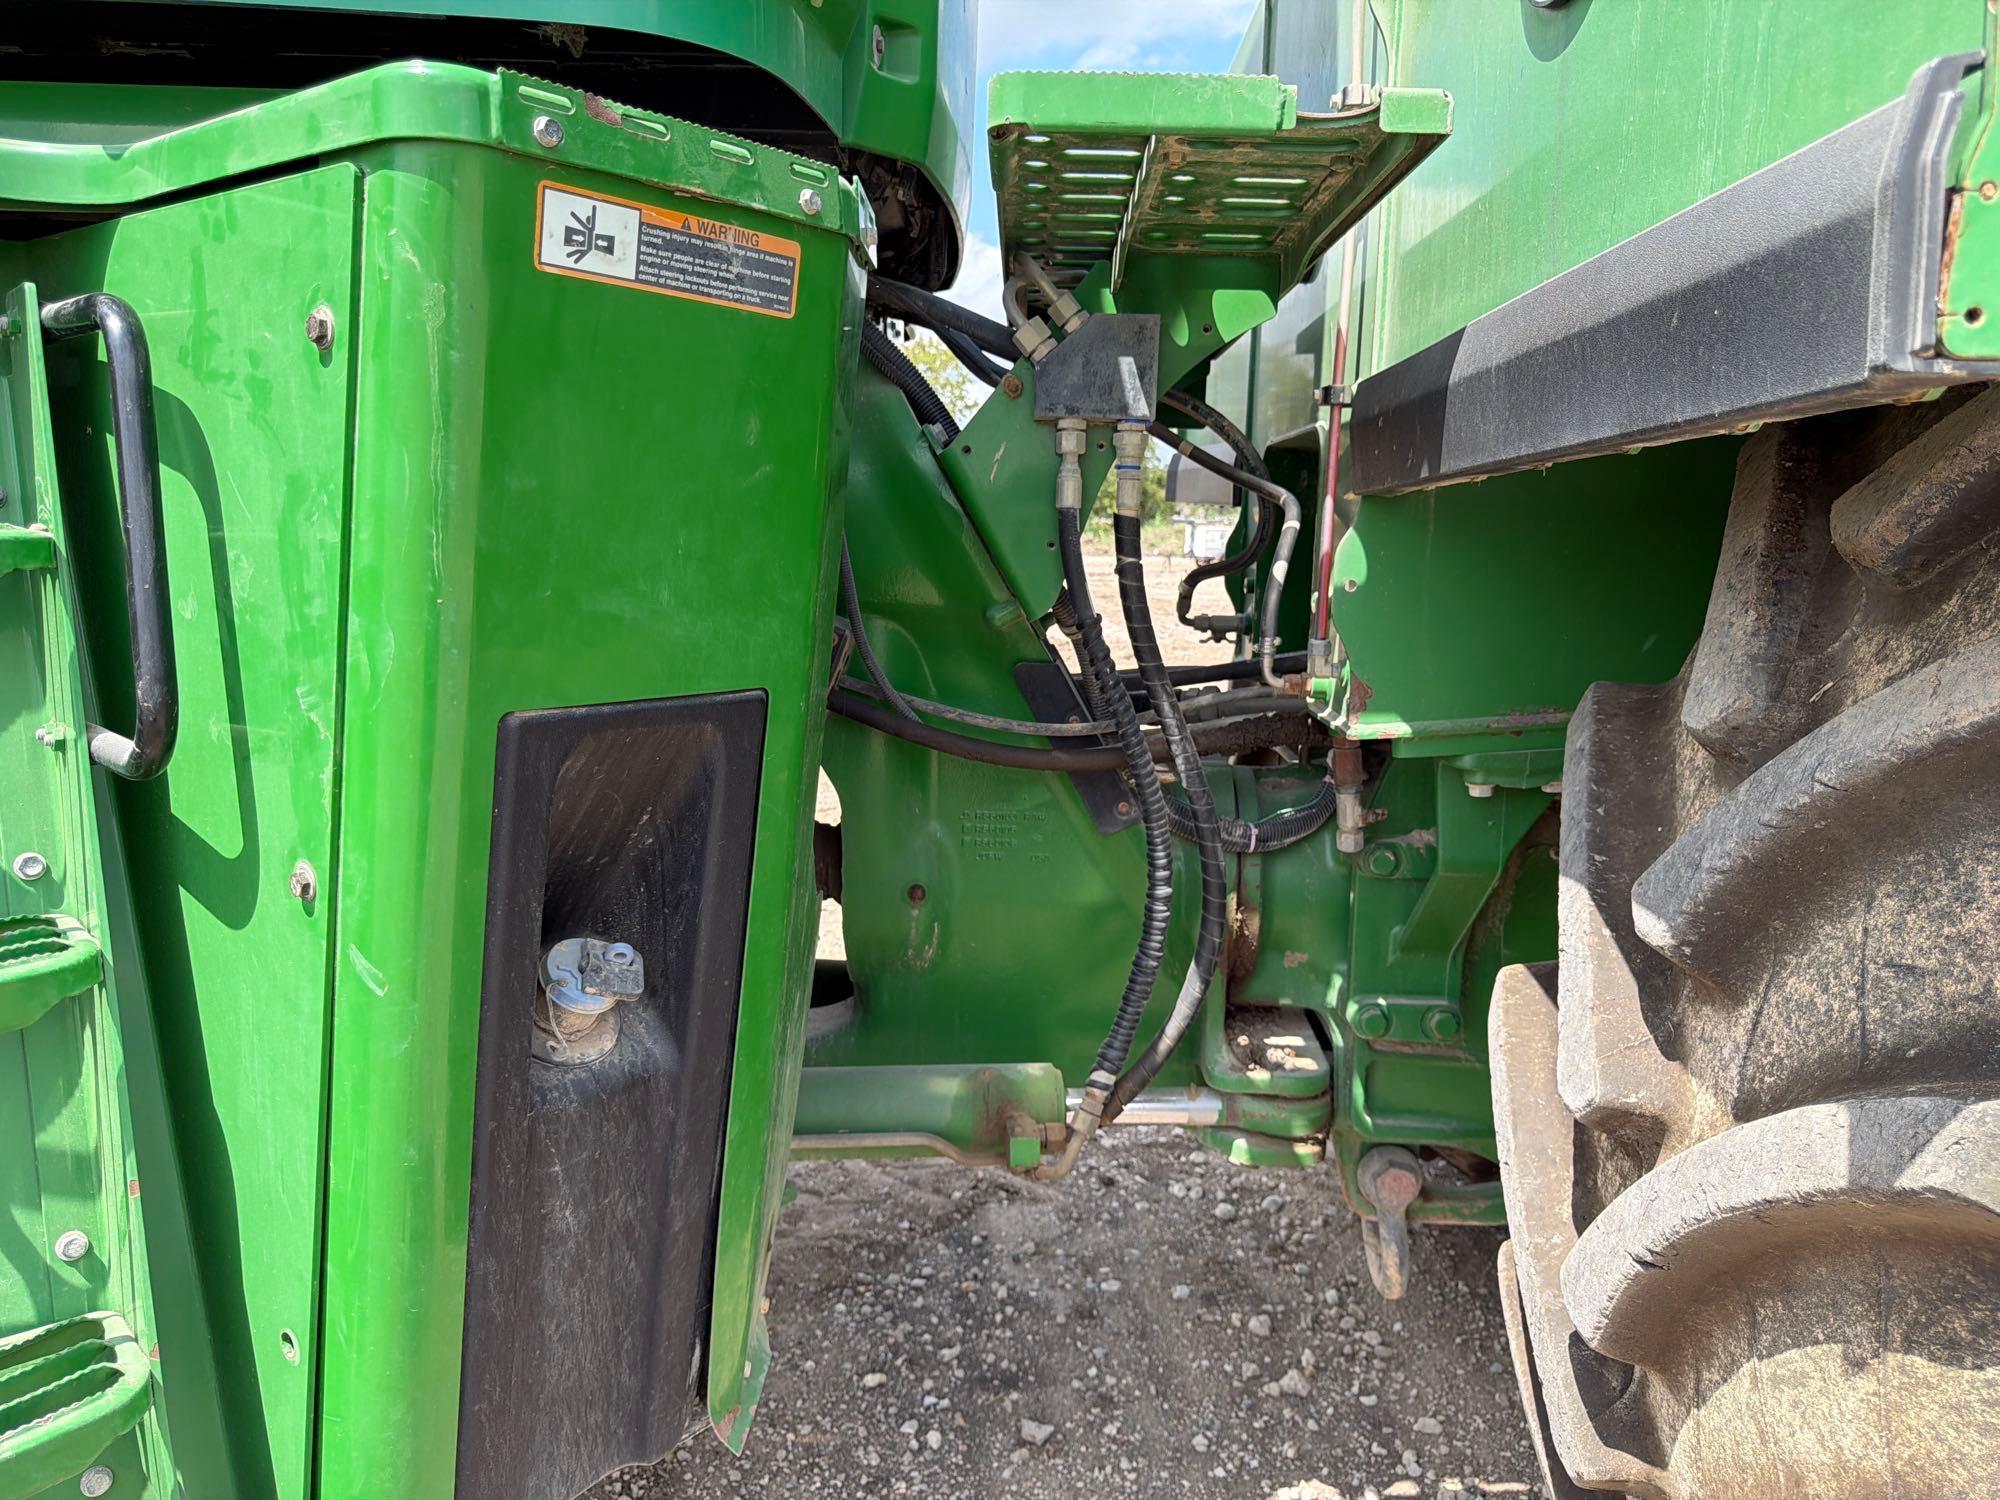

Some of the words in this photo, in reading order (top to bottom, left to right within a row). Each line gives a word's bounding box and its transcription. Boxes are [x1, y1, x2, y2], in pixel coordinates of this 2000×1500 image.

[641, 234, 663, 245] turned.
[642, 225, 670, 239] Crushing
[672, 232, 689, 244] injury
[691, 238, 703, 247] may
[765, 255, 787, 265] machine
[640, 254, 661, 264] engine
[670, 261, 692, 271] moving
[694, 266, 717, 277] steering
[641, 245, 657, 254] Make
[673, 254, 693, 263] people
[753, 271, 769, 279] before
[771, 275, 791, 285] starting
[639, 265, 658, 274] Attach
[660, 270, 684, 280] steering
[685, 274, 709, 285] lockouts
[710, 280, 728, 288] before
[729, 284, 757, 296] performing
[759, 291, 777, 299] service
[639, 274, 657, 282] center
[666, 279, 691, 289] machine
[699, 285, 733, 299] transporting
[746, 295, 761, 303] truck.
